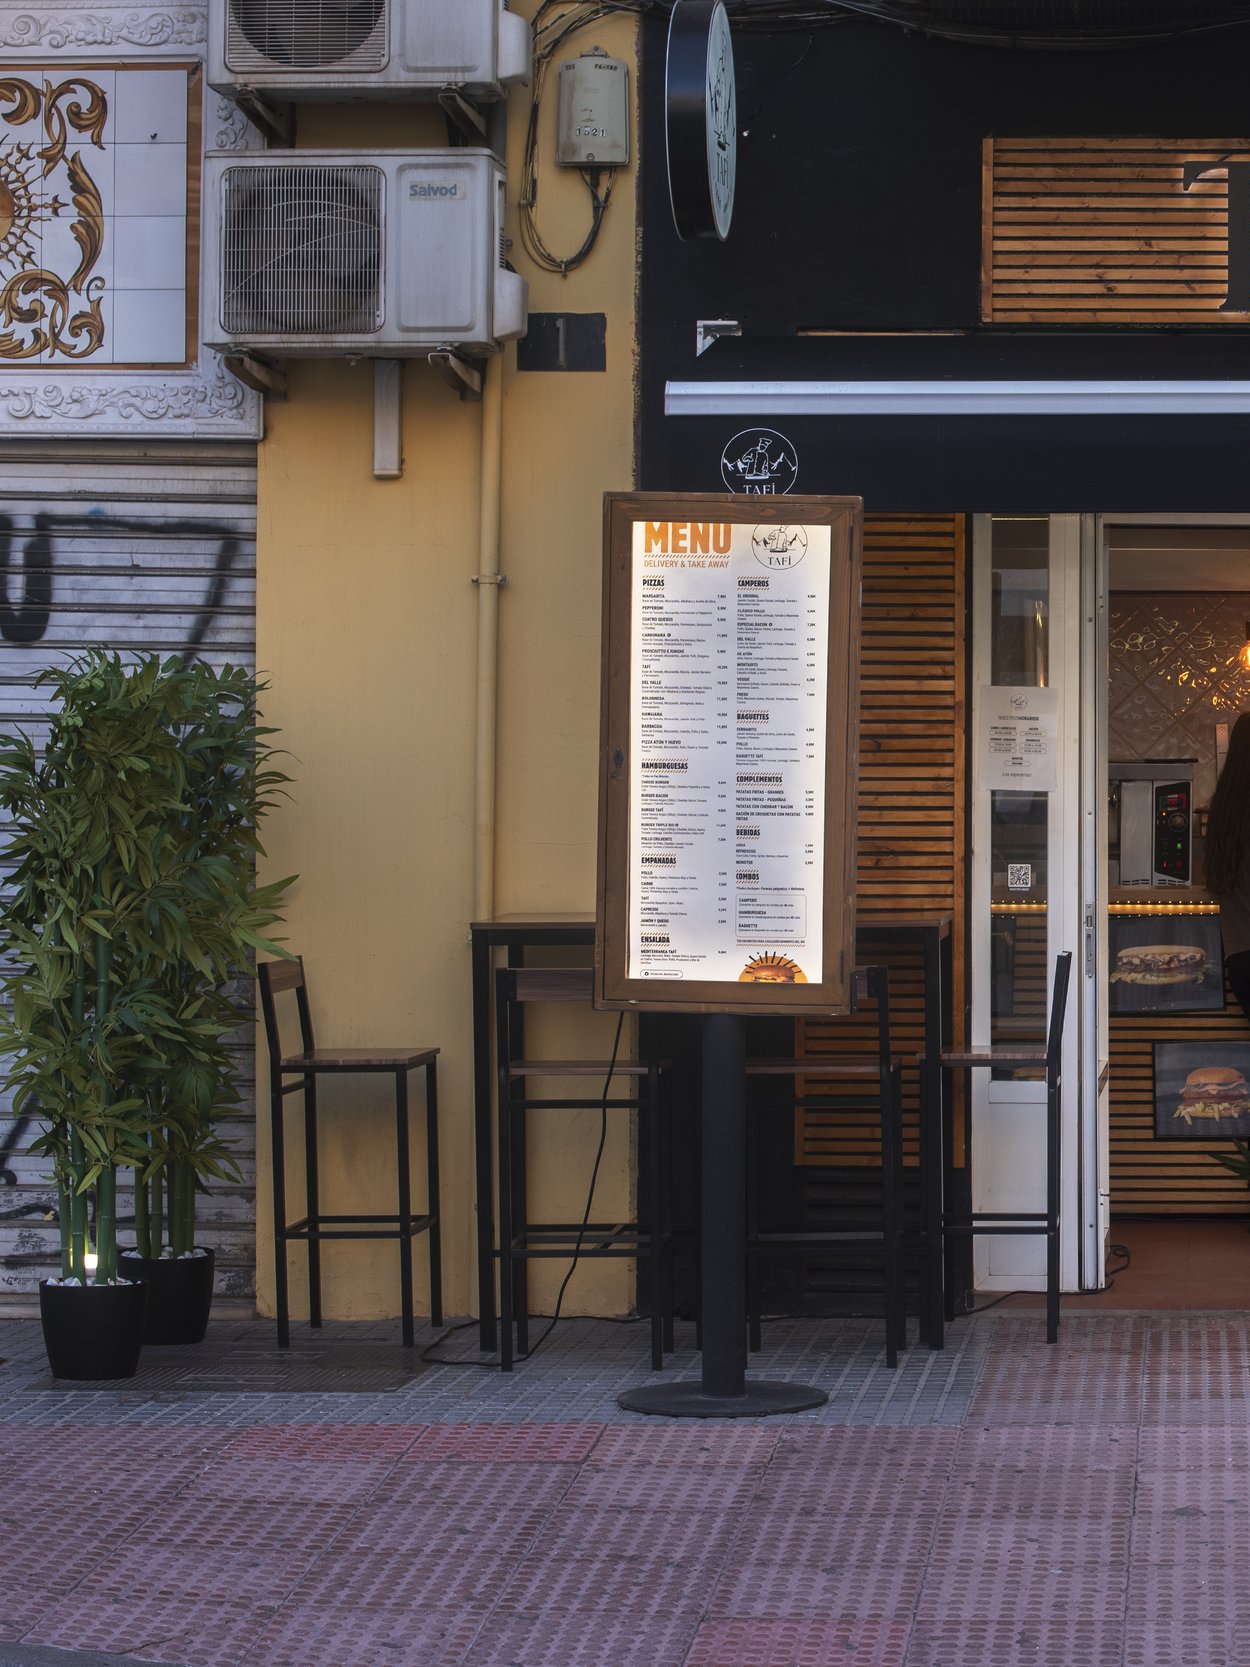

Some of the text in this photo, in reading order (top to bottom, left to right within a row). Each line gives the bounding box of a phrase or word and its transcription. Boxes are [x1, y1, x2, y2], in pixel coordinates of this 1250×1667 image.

[743, 483, 776, 494] TAFÍ
[644, 522, 731, 554] MENU
[768, 556, 791, 566] TAFÍ
